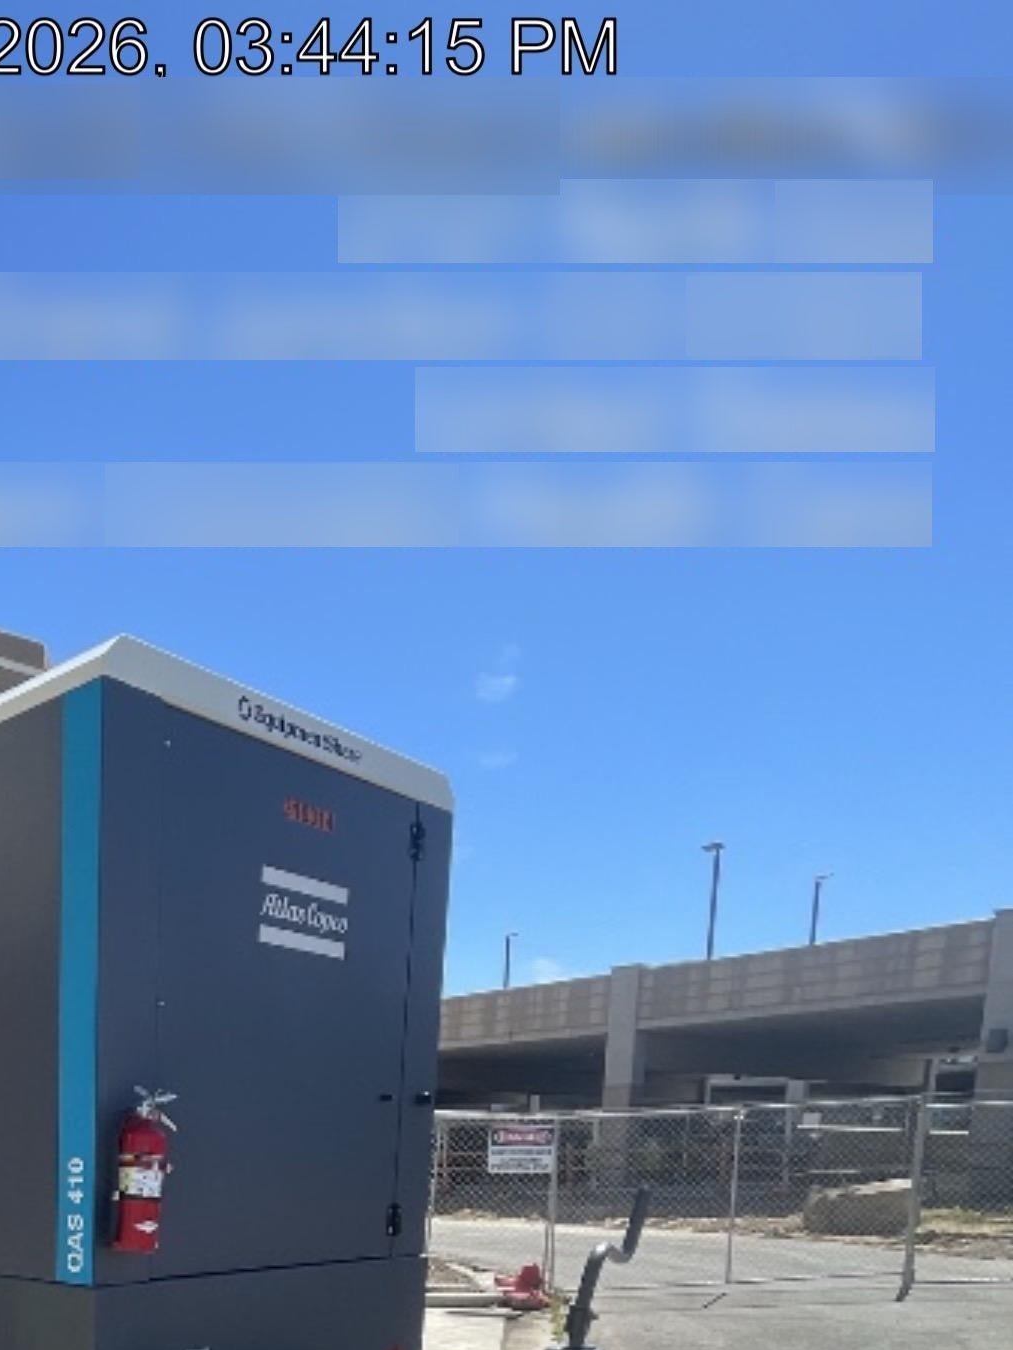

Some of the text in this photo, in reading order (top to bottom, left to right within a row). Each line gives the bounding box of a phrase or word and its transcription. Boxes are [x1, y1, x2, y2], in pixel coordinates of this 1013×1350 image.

[260, 893, 349, 934] Atlas Copco
[67, 1157, 85, 1274] QAS 410
